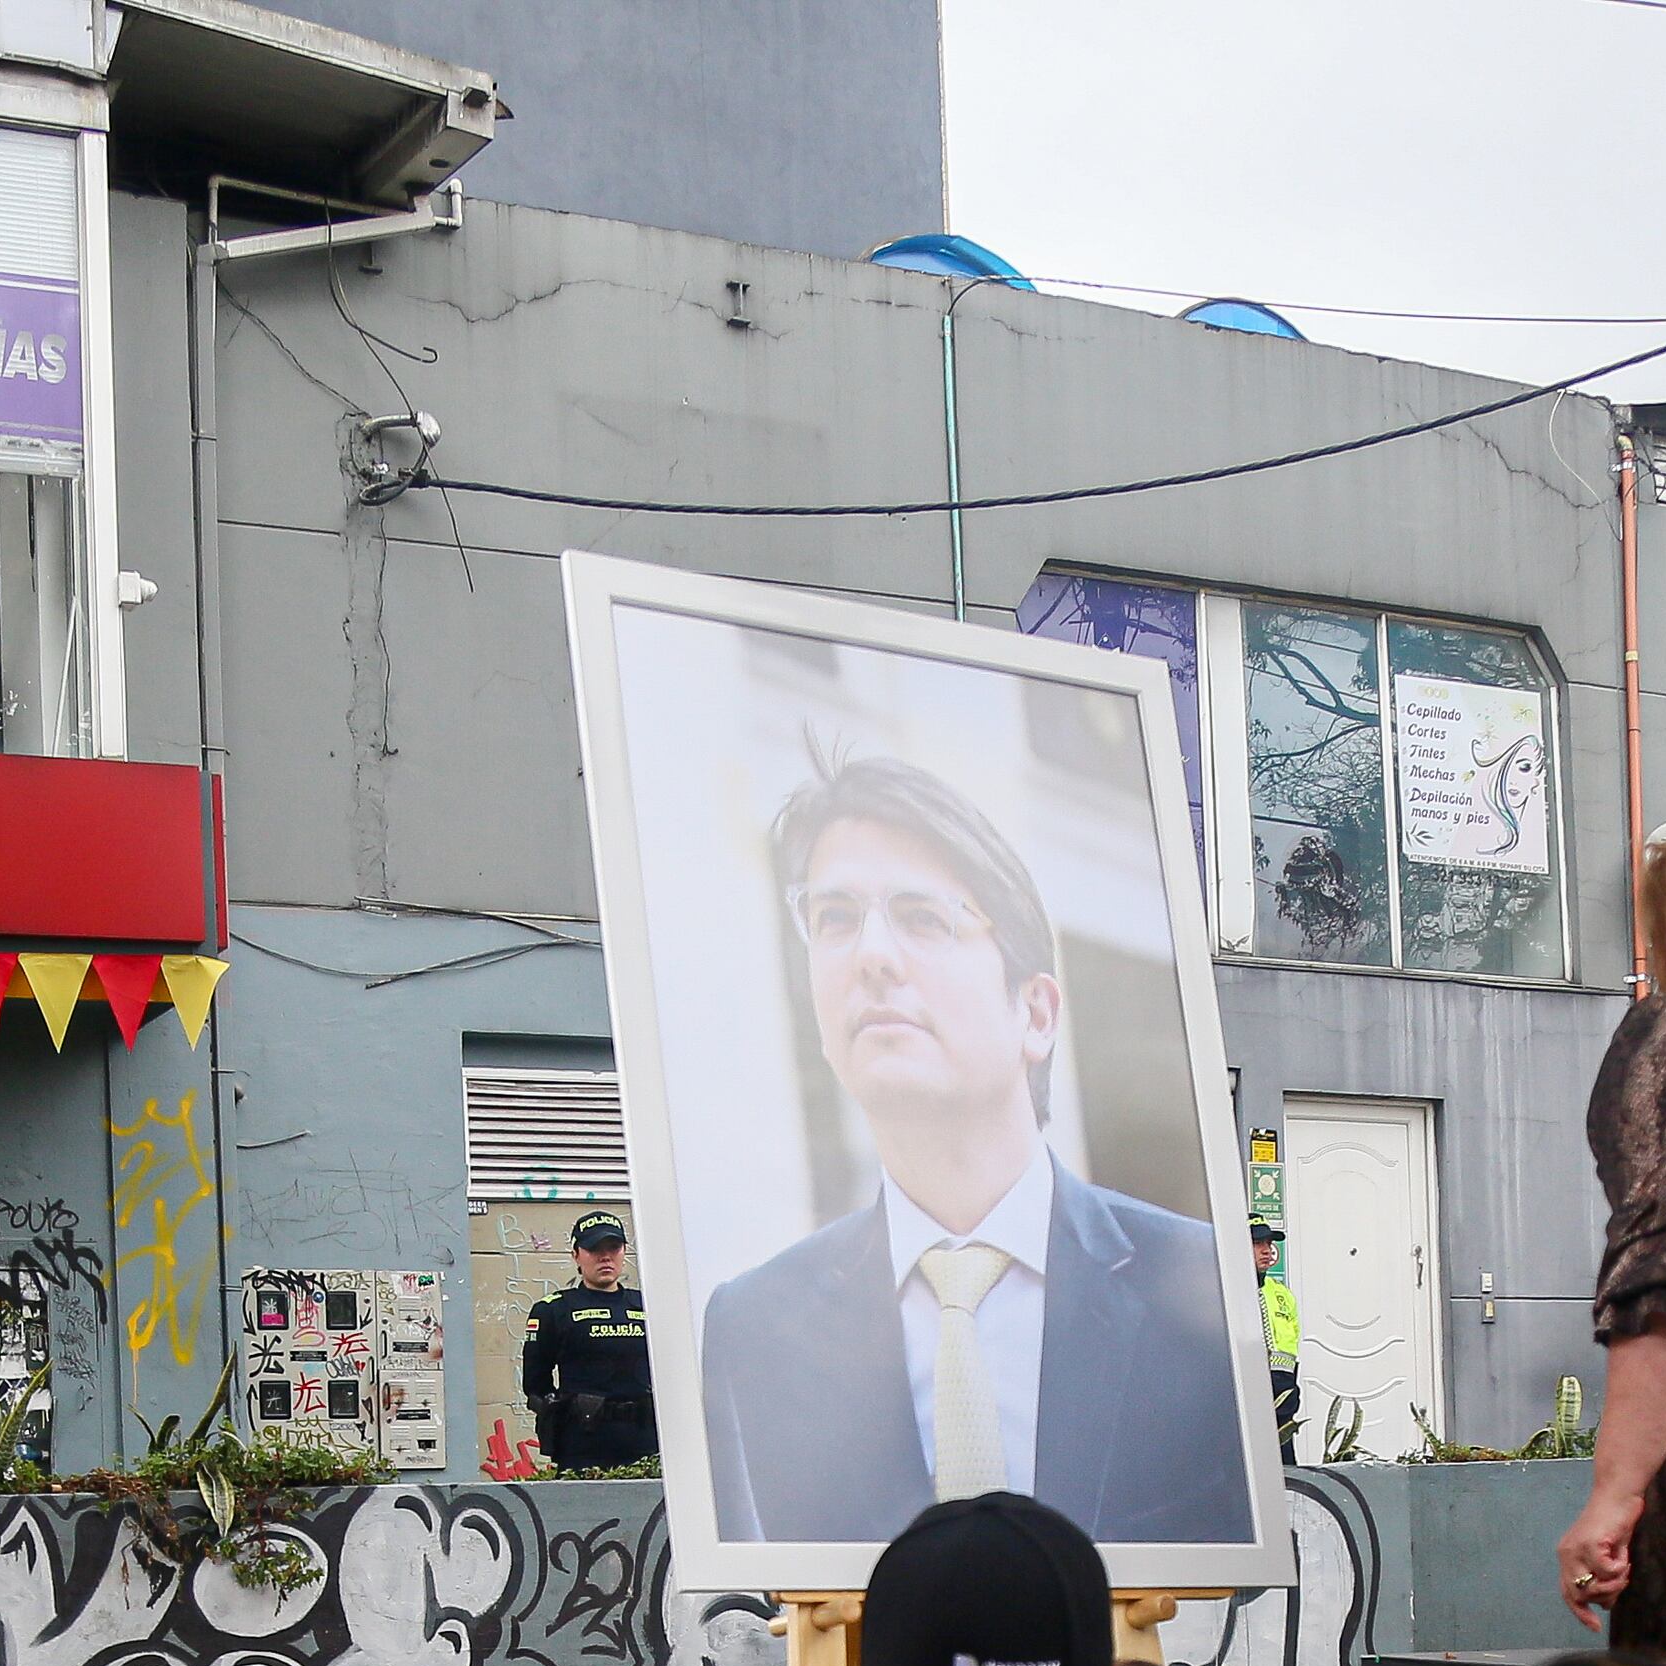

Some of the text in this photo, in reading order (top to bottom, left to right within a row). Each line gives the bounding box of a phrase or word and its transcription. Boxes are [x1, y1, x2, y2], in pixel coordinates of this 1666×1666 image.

[1407, 703, 1462, 721] Cepillado
[1408, 723, 1447, 740] Cortes
[1409, 744, 1446, 760] Tintes
[1409, 764, 1455, 781] Mechas
[1409, 787, 1472, 806] Depilación
[1411, 808, 1490, 825] manos y pies
[580, 1214, 621, 1232] POLICÍA
[591, 1323, 643, 1333] POLICÍA
